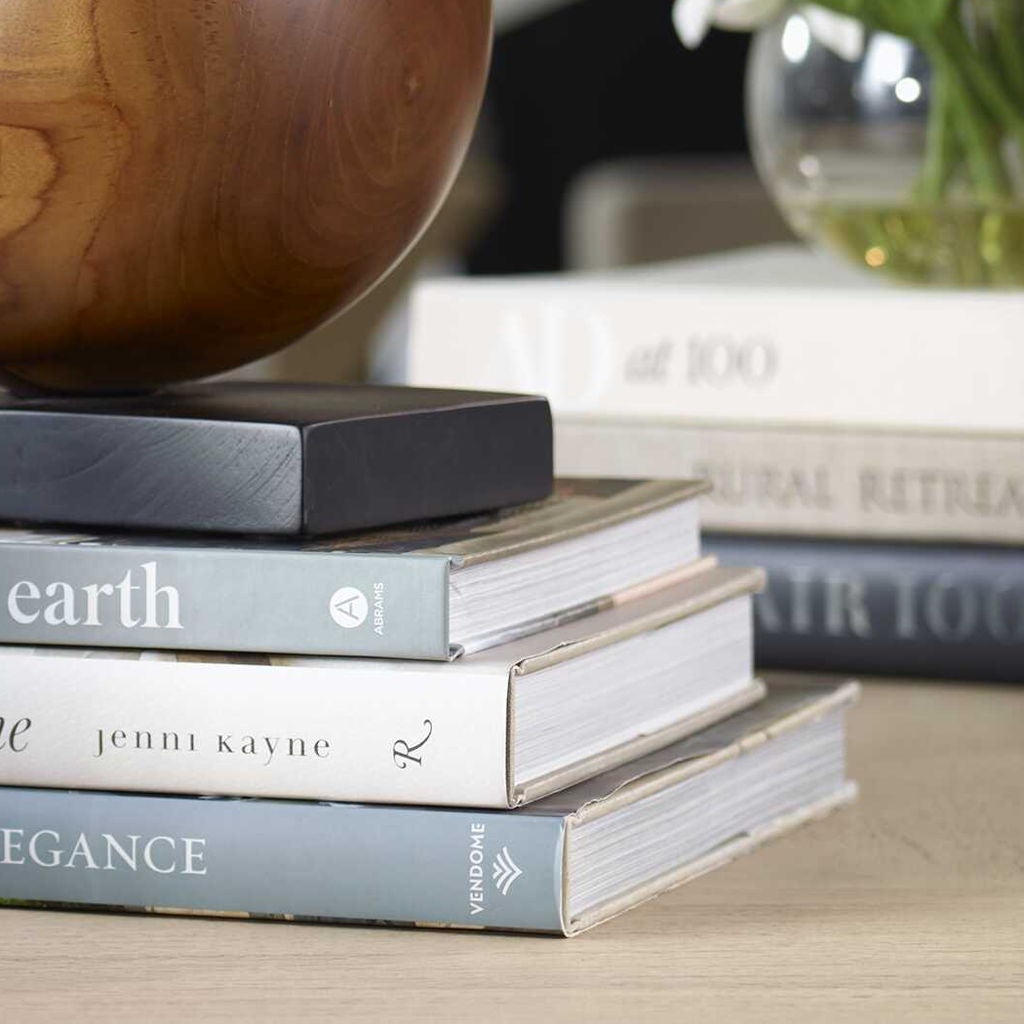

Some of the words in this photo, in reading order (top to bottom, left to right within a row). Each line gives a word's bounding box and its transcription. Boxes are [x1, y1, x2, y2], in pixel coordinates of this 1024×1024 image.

[685, 332, 780, 390] 100
[8, 561, 184, 630] earth
[373, 582, 385, 636] ABRAMS
[469, 823, 486, 916] VENDOME
